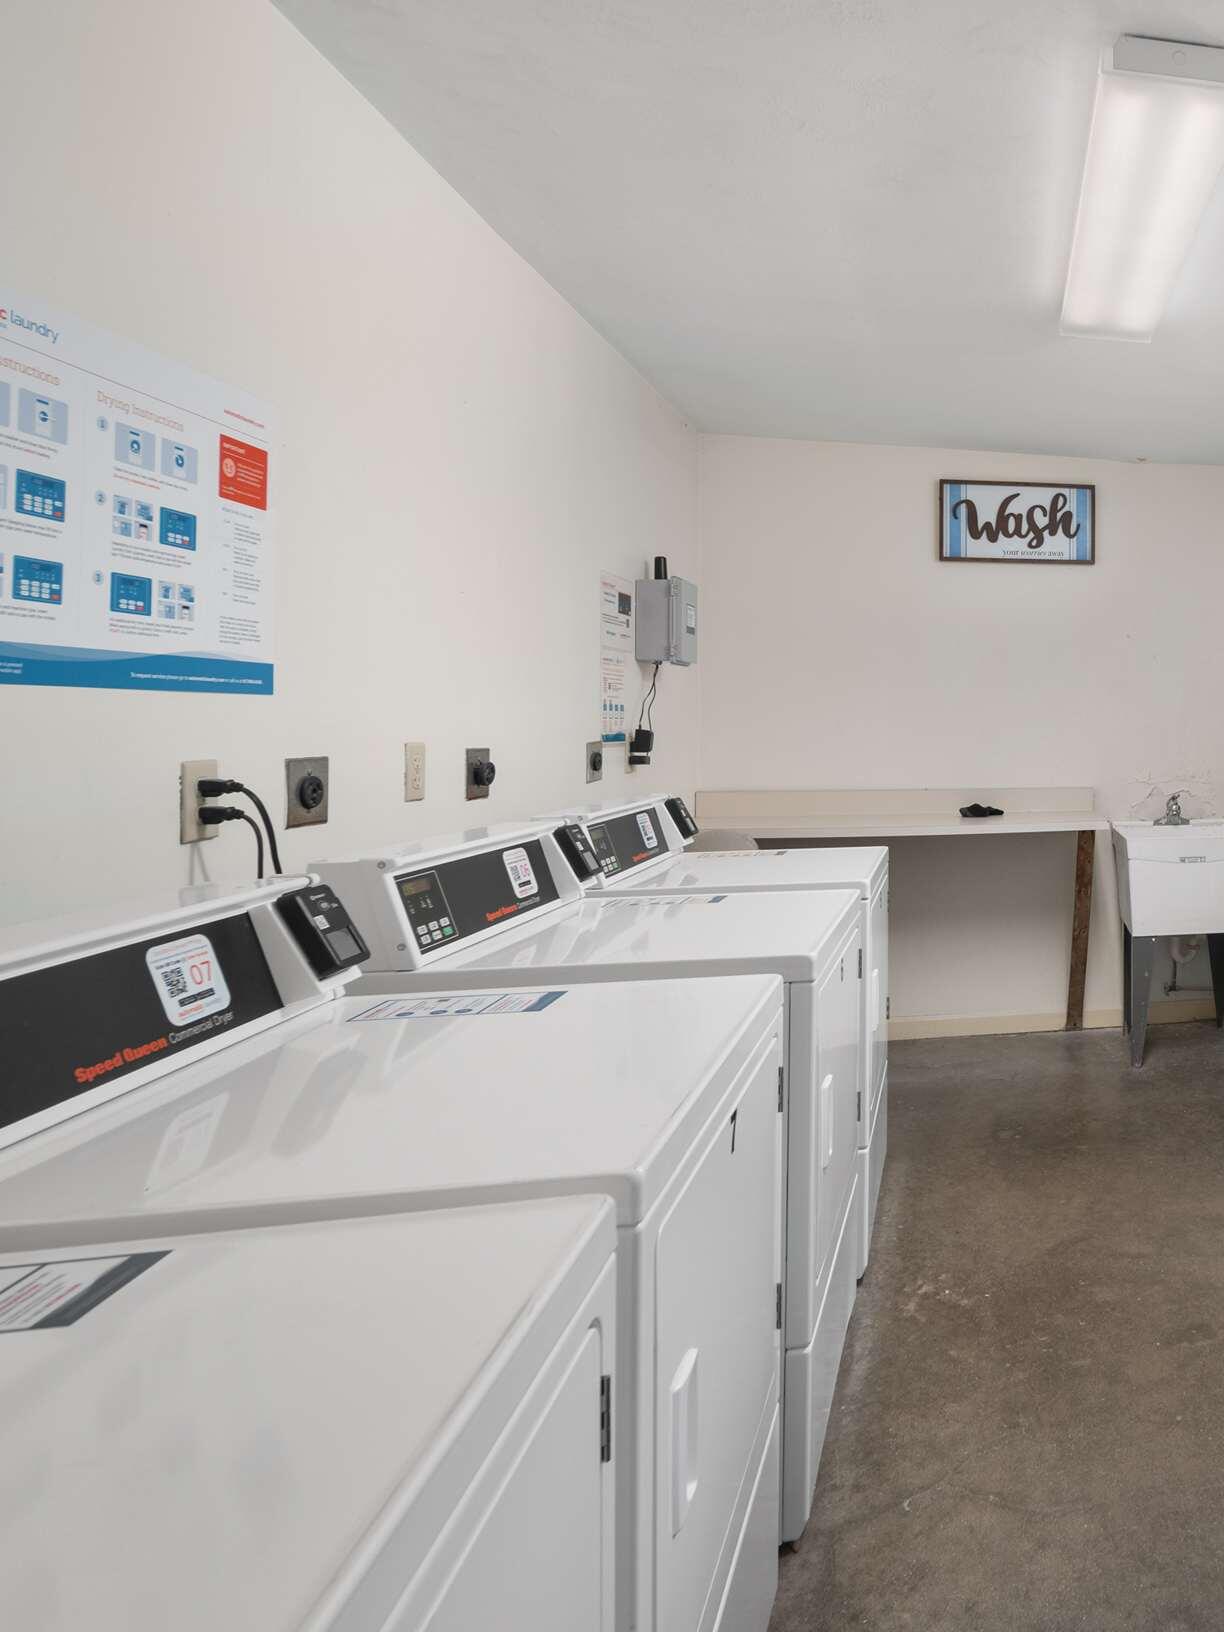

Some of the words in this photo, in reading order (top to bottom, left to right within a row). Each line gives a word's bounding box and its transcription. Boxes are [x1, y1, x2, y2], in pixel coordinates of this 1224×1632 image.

[10, 309, 60, 344] laundry
[952, 493, 1080, 549] Wash
[190, 960, 212, 986] 07
[74, 1052, 124, 1083] Speed
[122, 1037, 169, 1063] Queen
[169, 1017, 213, 1044] Commercial
[214, 1011, 234, 1029] Dryer
